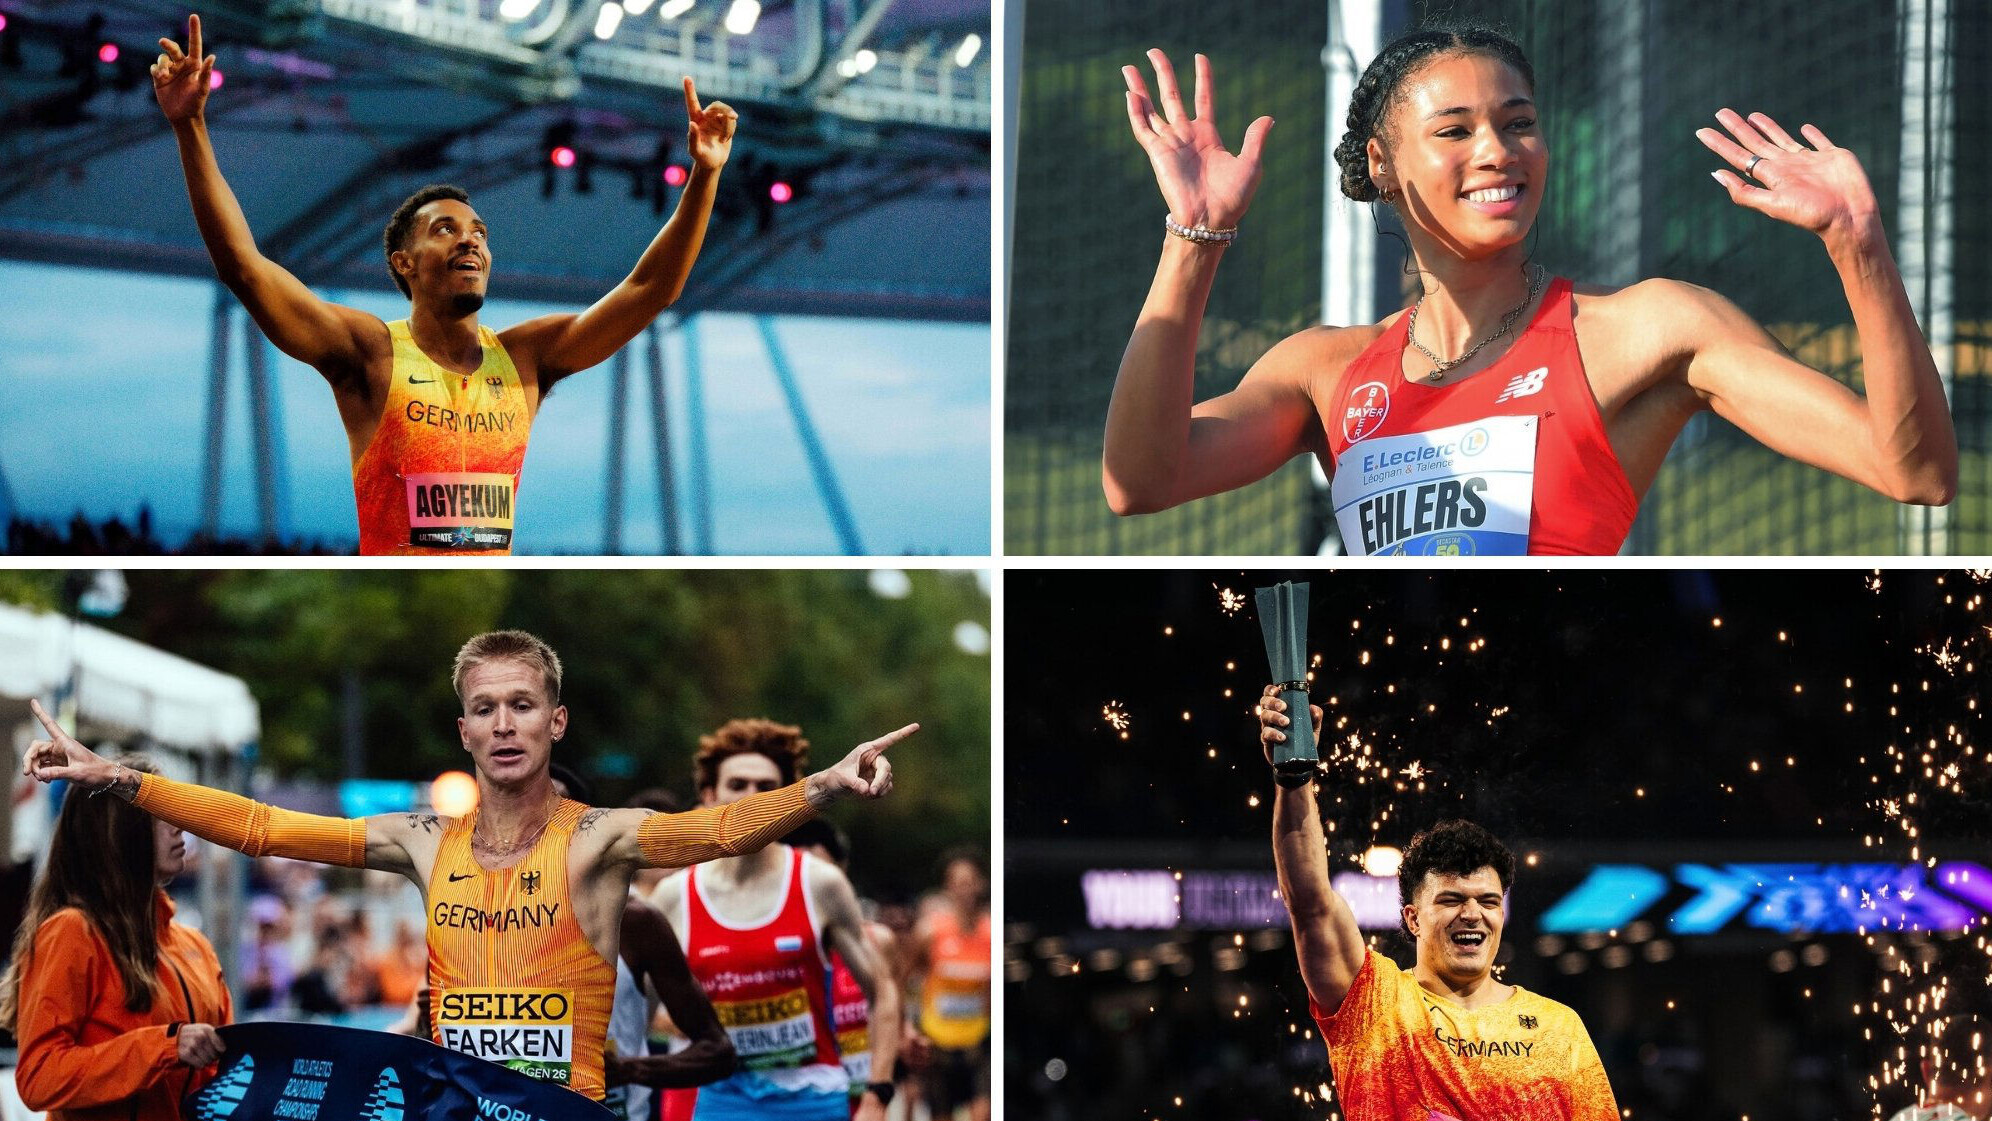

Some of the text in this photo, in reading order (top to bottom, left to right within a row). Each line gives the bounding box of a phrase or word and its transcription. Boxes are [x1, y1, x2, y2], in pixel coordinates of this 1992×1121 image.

[406, 400, 516, 433] GERMANY
[1346, 407, 1384, 419] BAYER
[1363, 442, 1456, 473] E.Leclerc
[1363, 459, 1454, 486] Léognan & Talence
[416, 483, 510, 520] AGYEKUM
[1359, 477, 1488, 555] EHLERS
[419, 533, 453, 543] ULTIMATE
[434, 902, 559, 933] GERMANY
[441, 993, 568, 1021] SEIKO
[445, 1028, 563, 1058] FARKEN
[1435, 1027, 1533, 1057] GERMANY
[552, 1069, 567, 1079] 26
